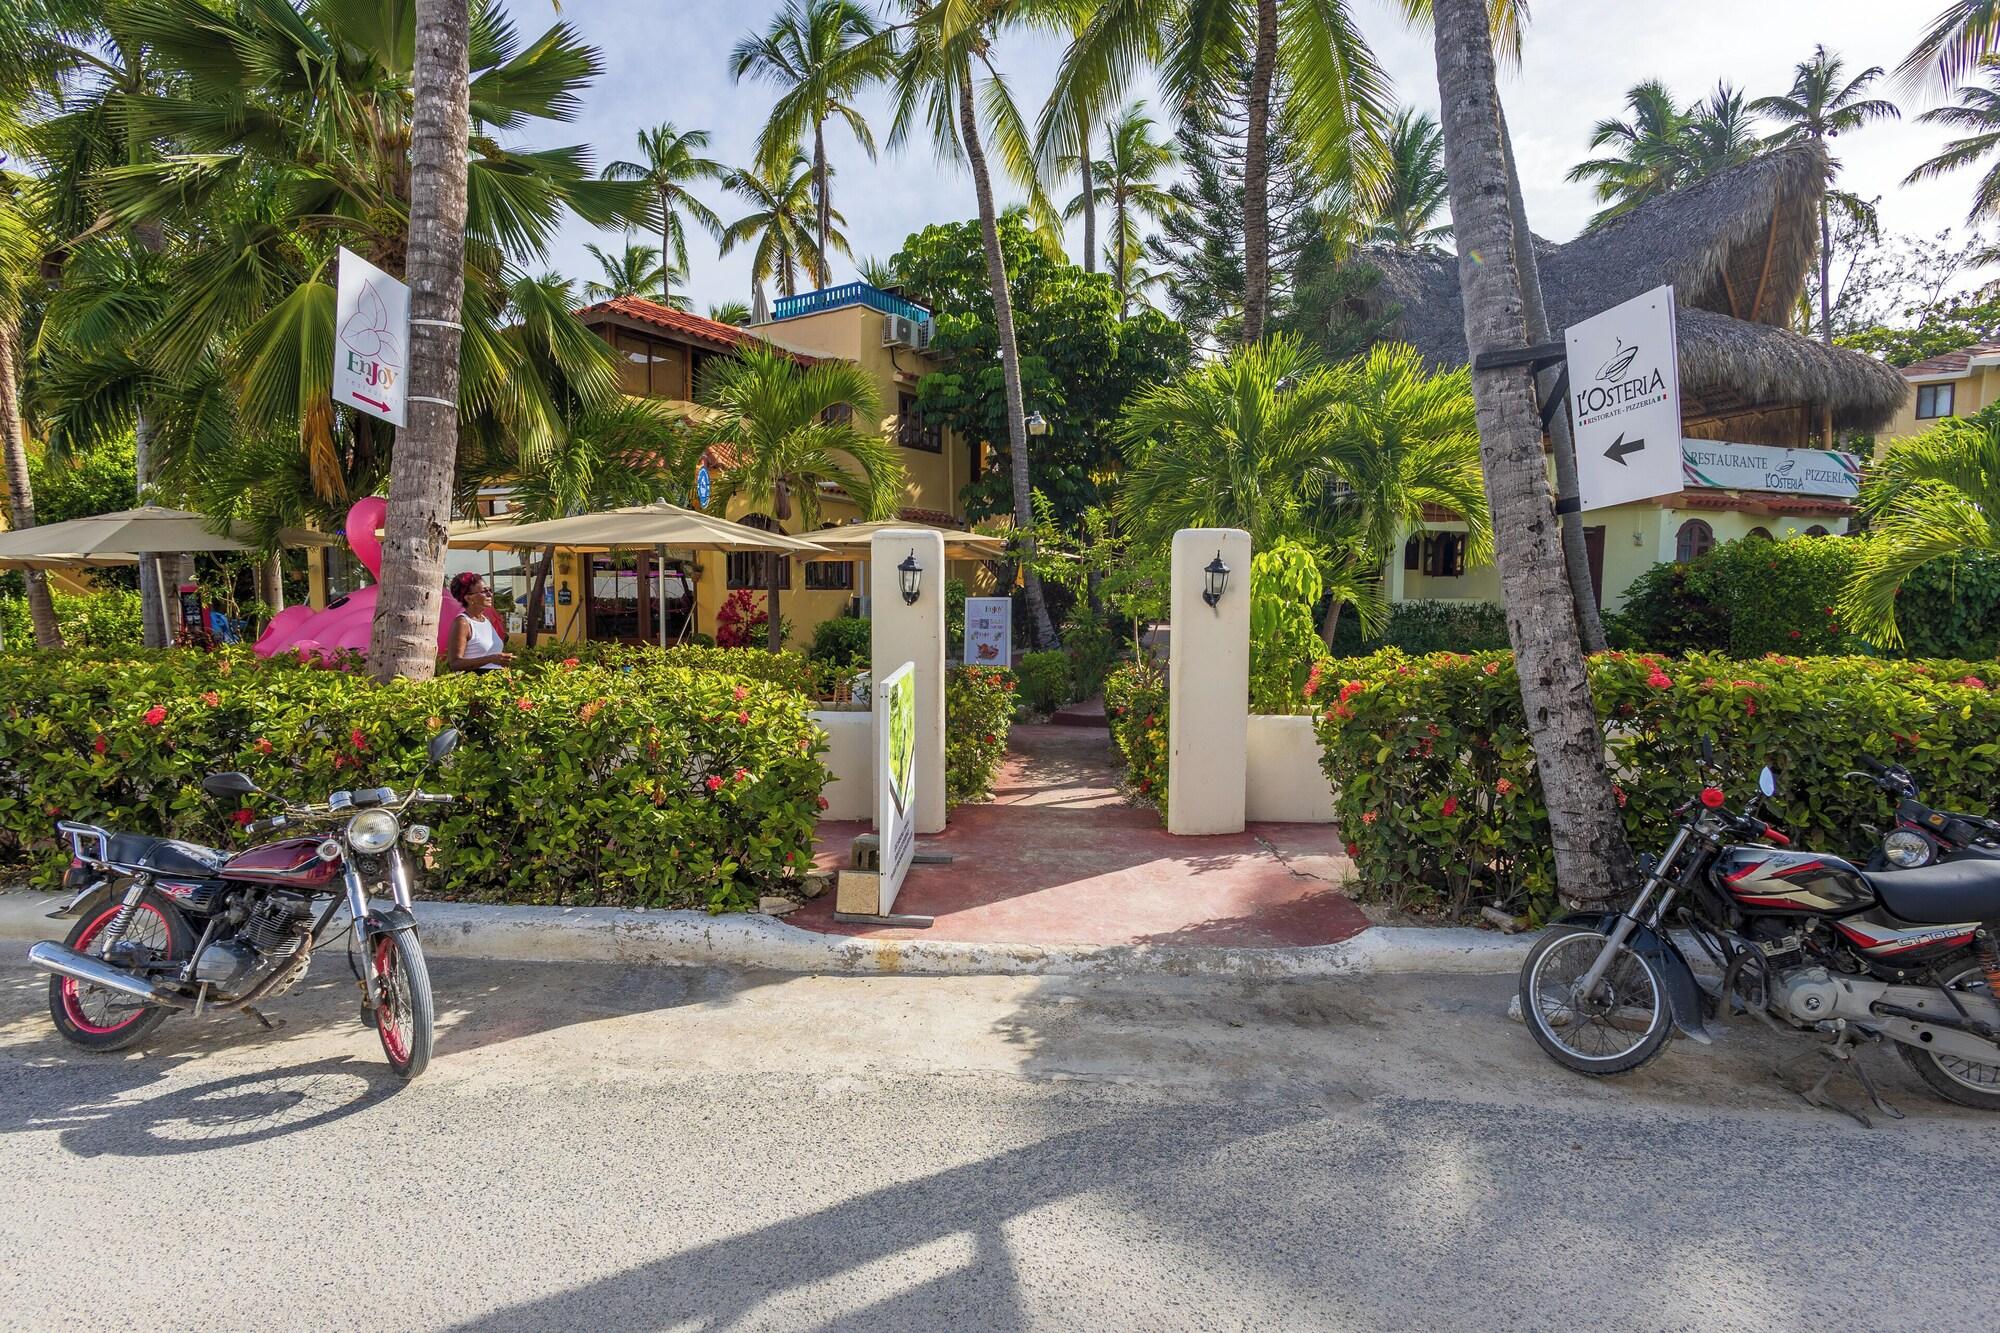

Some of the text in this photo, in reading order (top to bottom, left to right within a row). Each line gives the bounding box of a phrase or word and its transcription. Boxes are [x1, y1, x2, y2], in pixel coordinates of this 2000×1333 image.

[1577, 367, 1666, 418] L'OSTERIA
[1625, 398, 1657, 413] PIZZERIA
[1690, 451, 1768, 470] RESTAURANTE
[1765, 473, 1805, 491] L'OSTERIA
